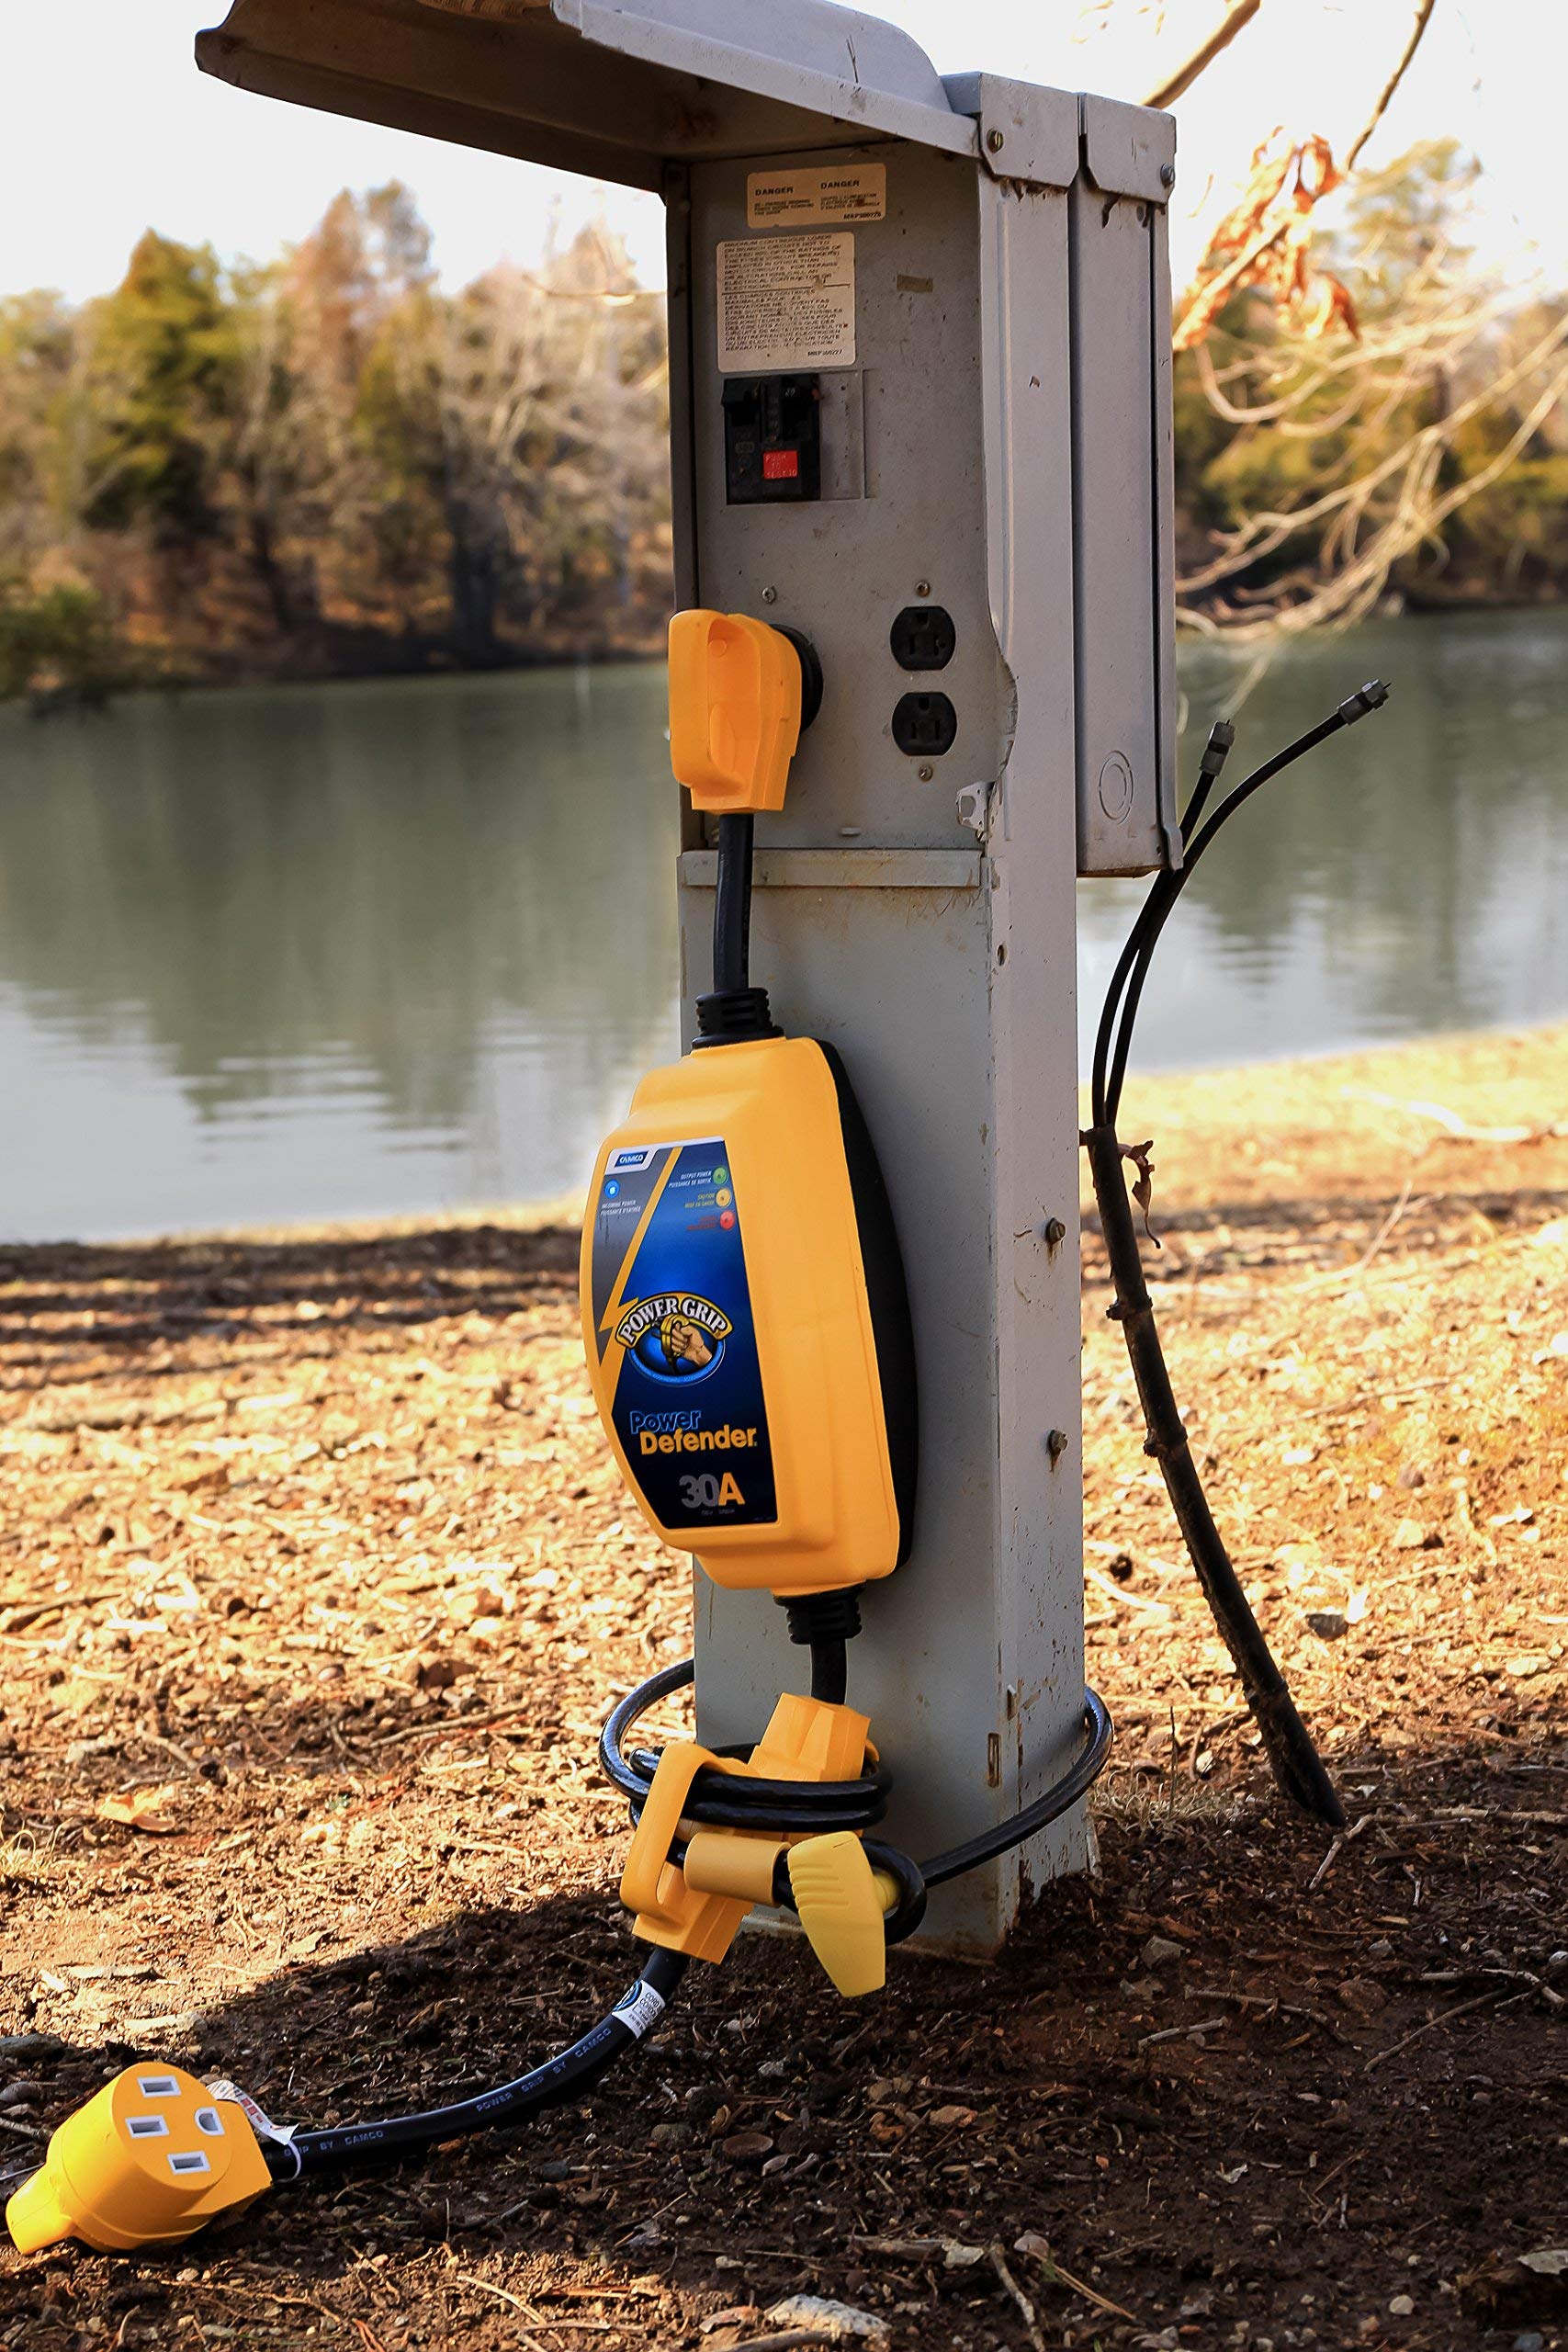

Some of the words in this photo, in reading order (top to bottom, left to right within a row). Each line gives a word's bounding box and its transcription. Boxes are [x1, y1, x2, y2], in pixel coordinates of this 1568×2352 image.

[755, 187, 794, 196] DANGER
[820, 180, 860, 189] DANGER
[619, 1154, 644, 1165] CAMCO
[620, 1297, 678, 1343] POWER
[682, 1297, 726, 1332] GRIP
[629, 1410, 702, 1435] Power
[639, 1424, 756, 1455] Defender
[678, 1472, 746, 1509] 30A
[476, 2092, 513, 2112] POWER
[522, 2075, 545, 2092] GRIP
[551, 2061, 567, 2074] BY
[574, 2027, 613, 2058] CAMCO
[284, 2145, 310, 2157] GIP
[320, 2140, 333, 2151] BY
[344, 2130, 385, 2145] CAMCO
